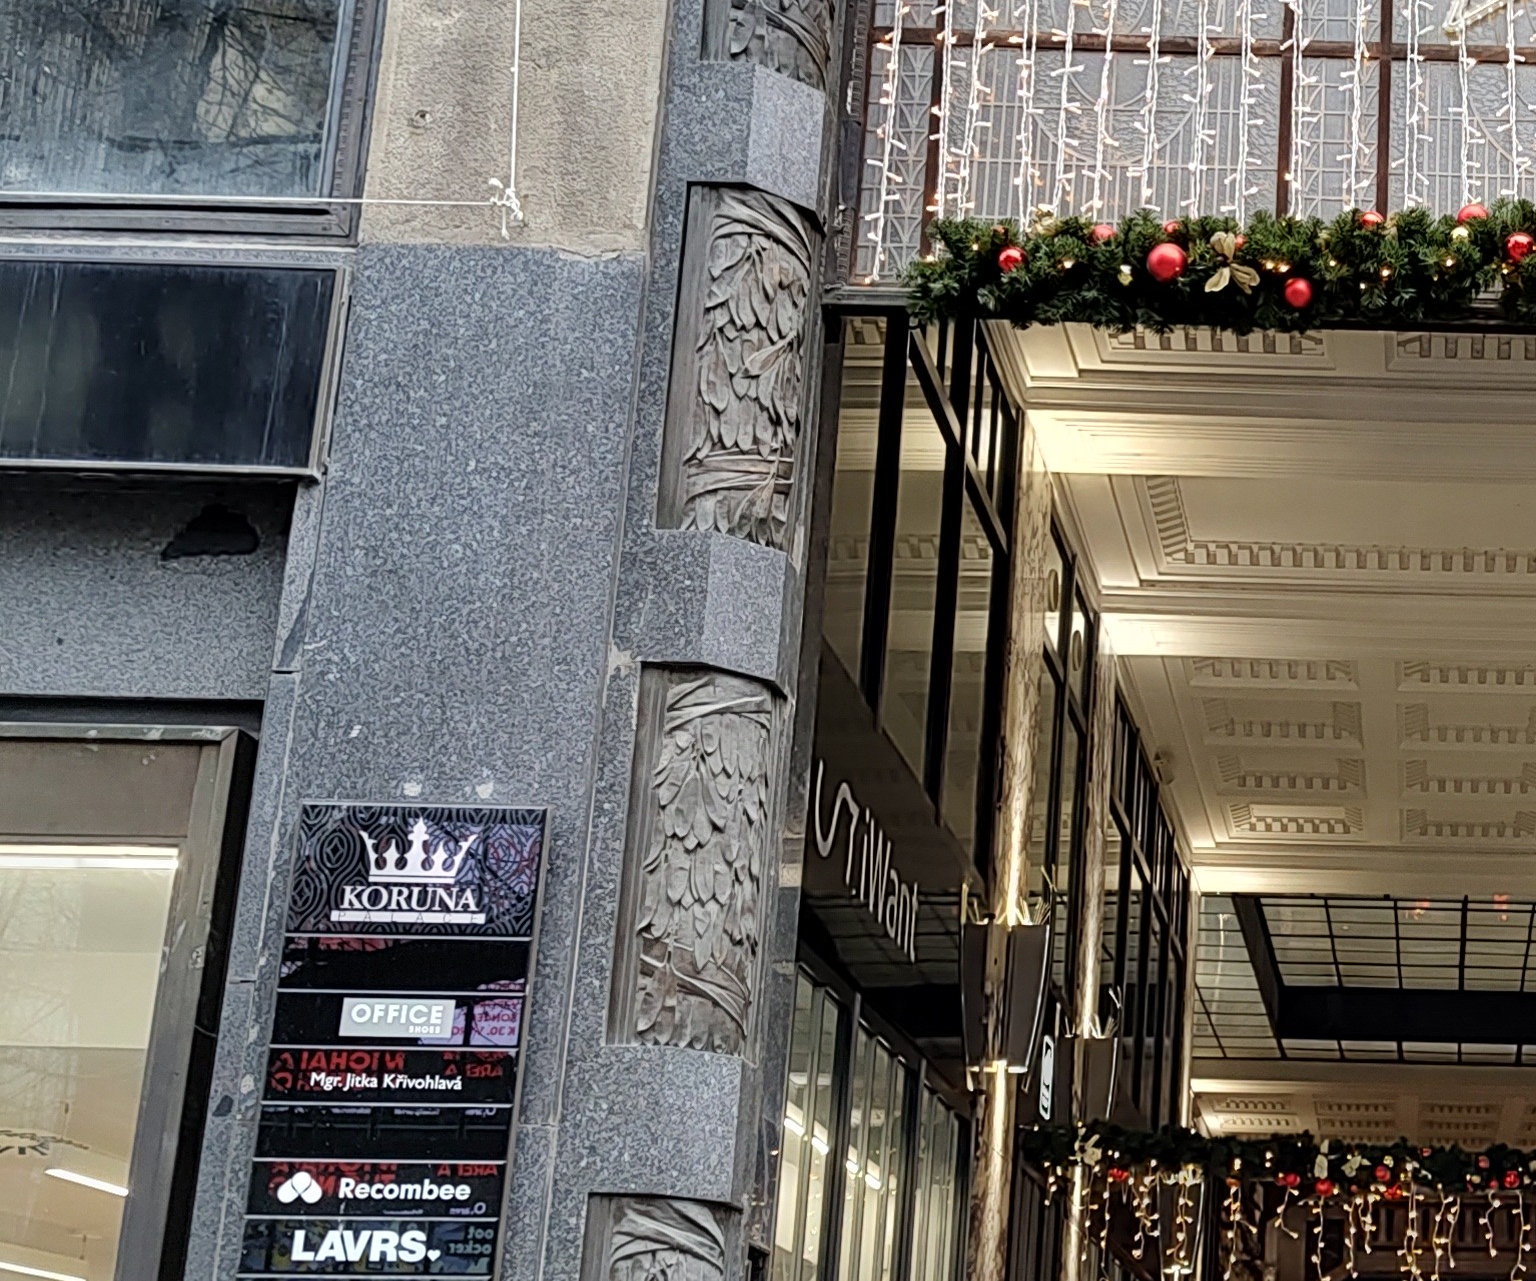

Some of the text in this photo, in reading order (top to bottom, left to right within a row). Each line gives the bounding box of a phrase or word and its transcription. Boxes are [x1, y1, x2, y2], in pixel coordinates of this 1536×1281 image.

[340, 885, 479, 911] KORUNA
[350, 1003, 444, 1024] OFFICE
[310, 1071, 462, 1091] Mgr. Jitka Křivohlavá
[338, 1177, 471, 1201] Recombee
